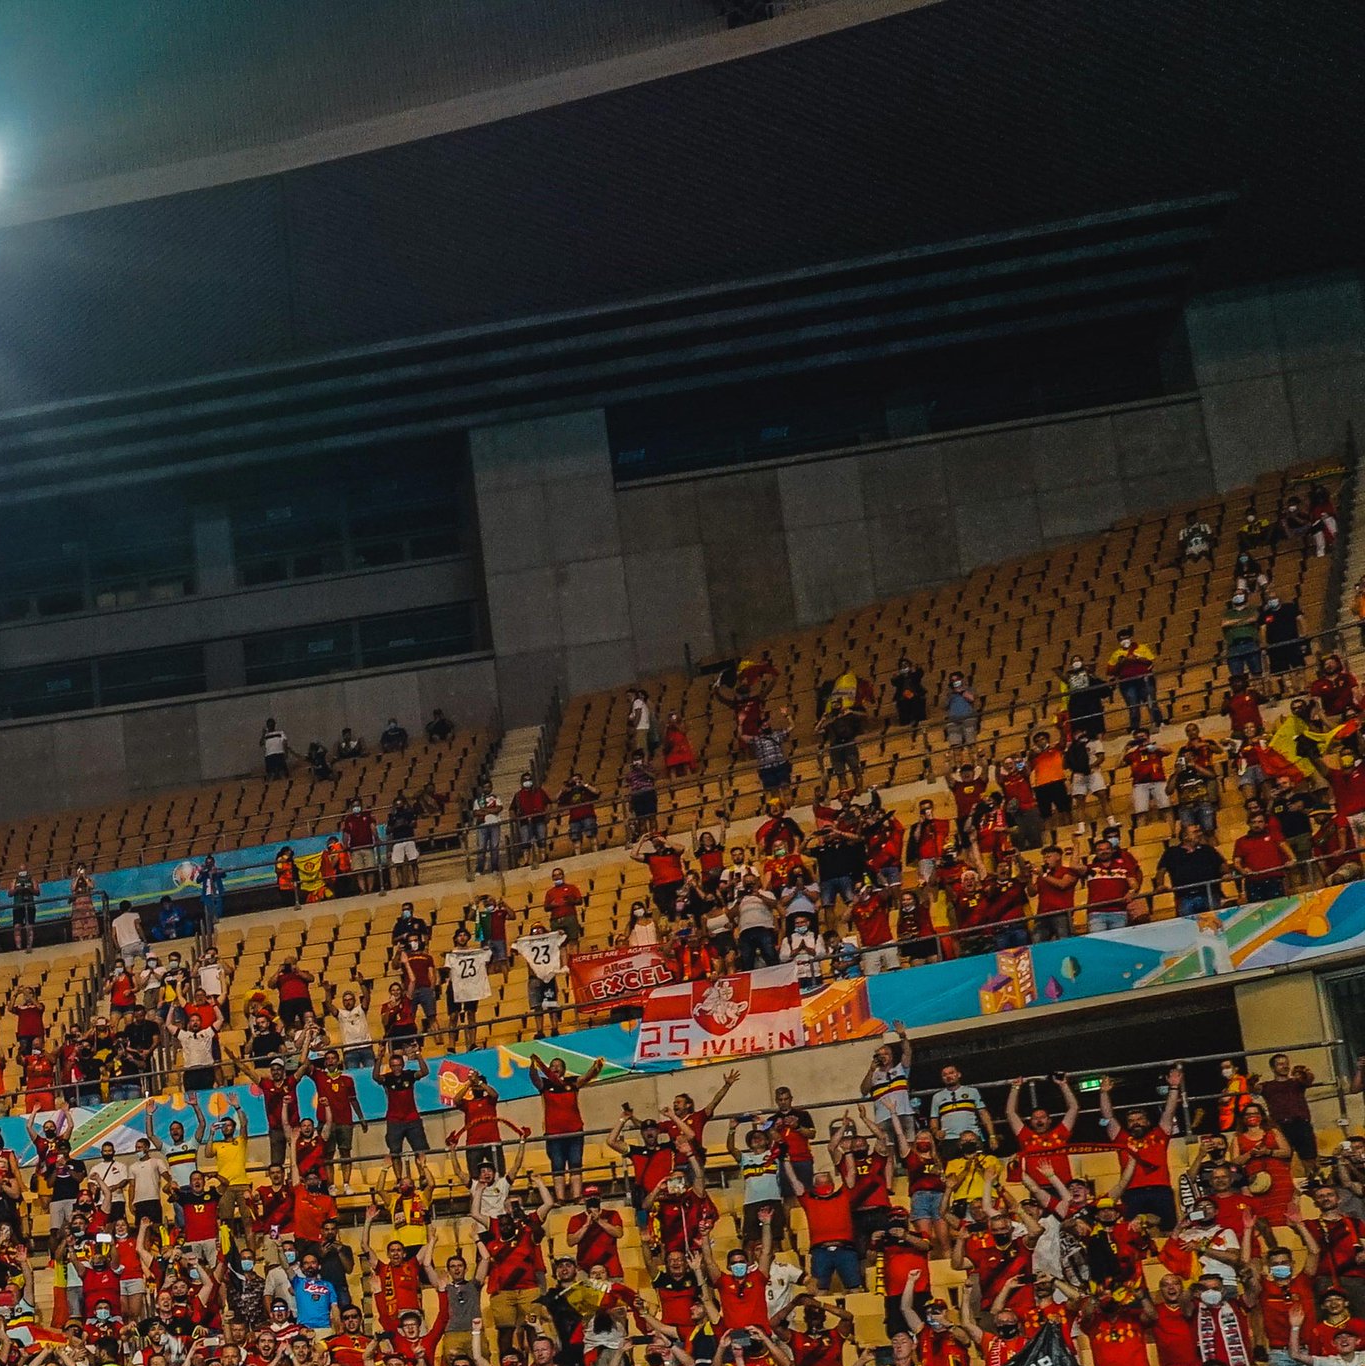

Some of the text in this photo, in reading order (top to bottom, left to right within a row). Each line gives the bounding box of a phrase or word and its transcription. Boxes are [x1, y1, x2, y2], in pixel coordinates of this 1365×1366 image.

[531, 945, 551, 966] 23
[460, 957, 476, 980] 23
[590, 964, 672, 1000] EXCEL
[640, 1023, 689, 1058] 25
[193, 1203, 206, 1214] 12
